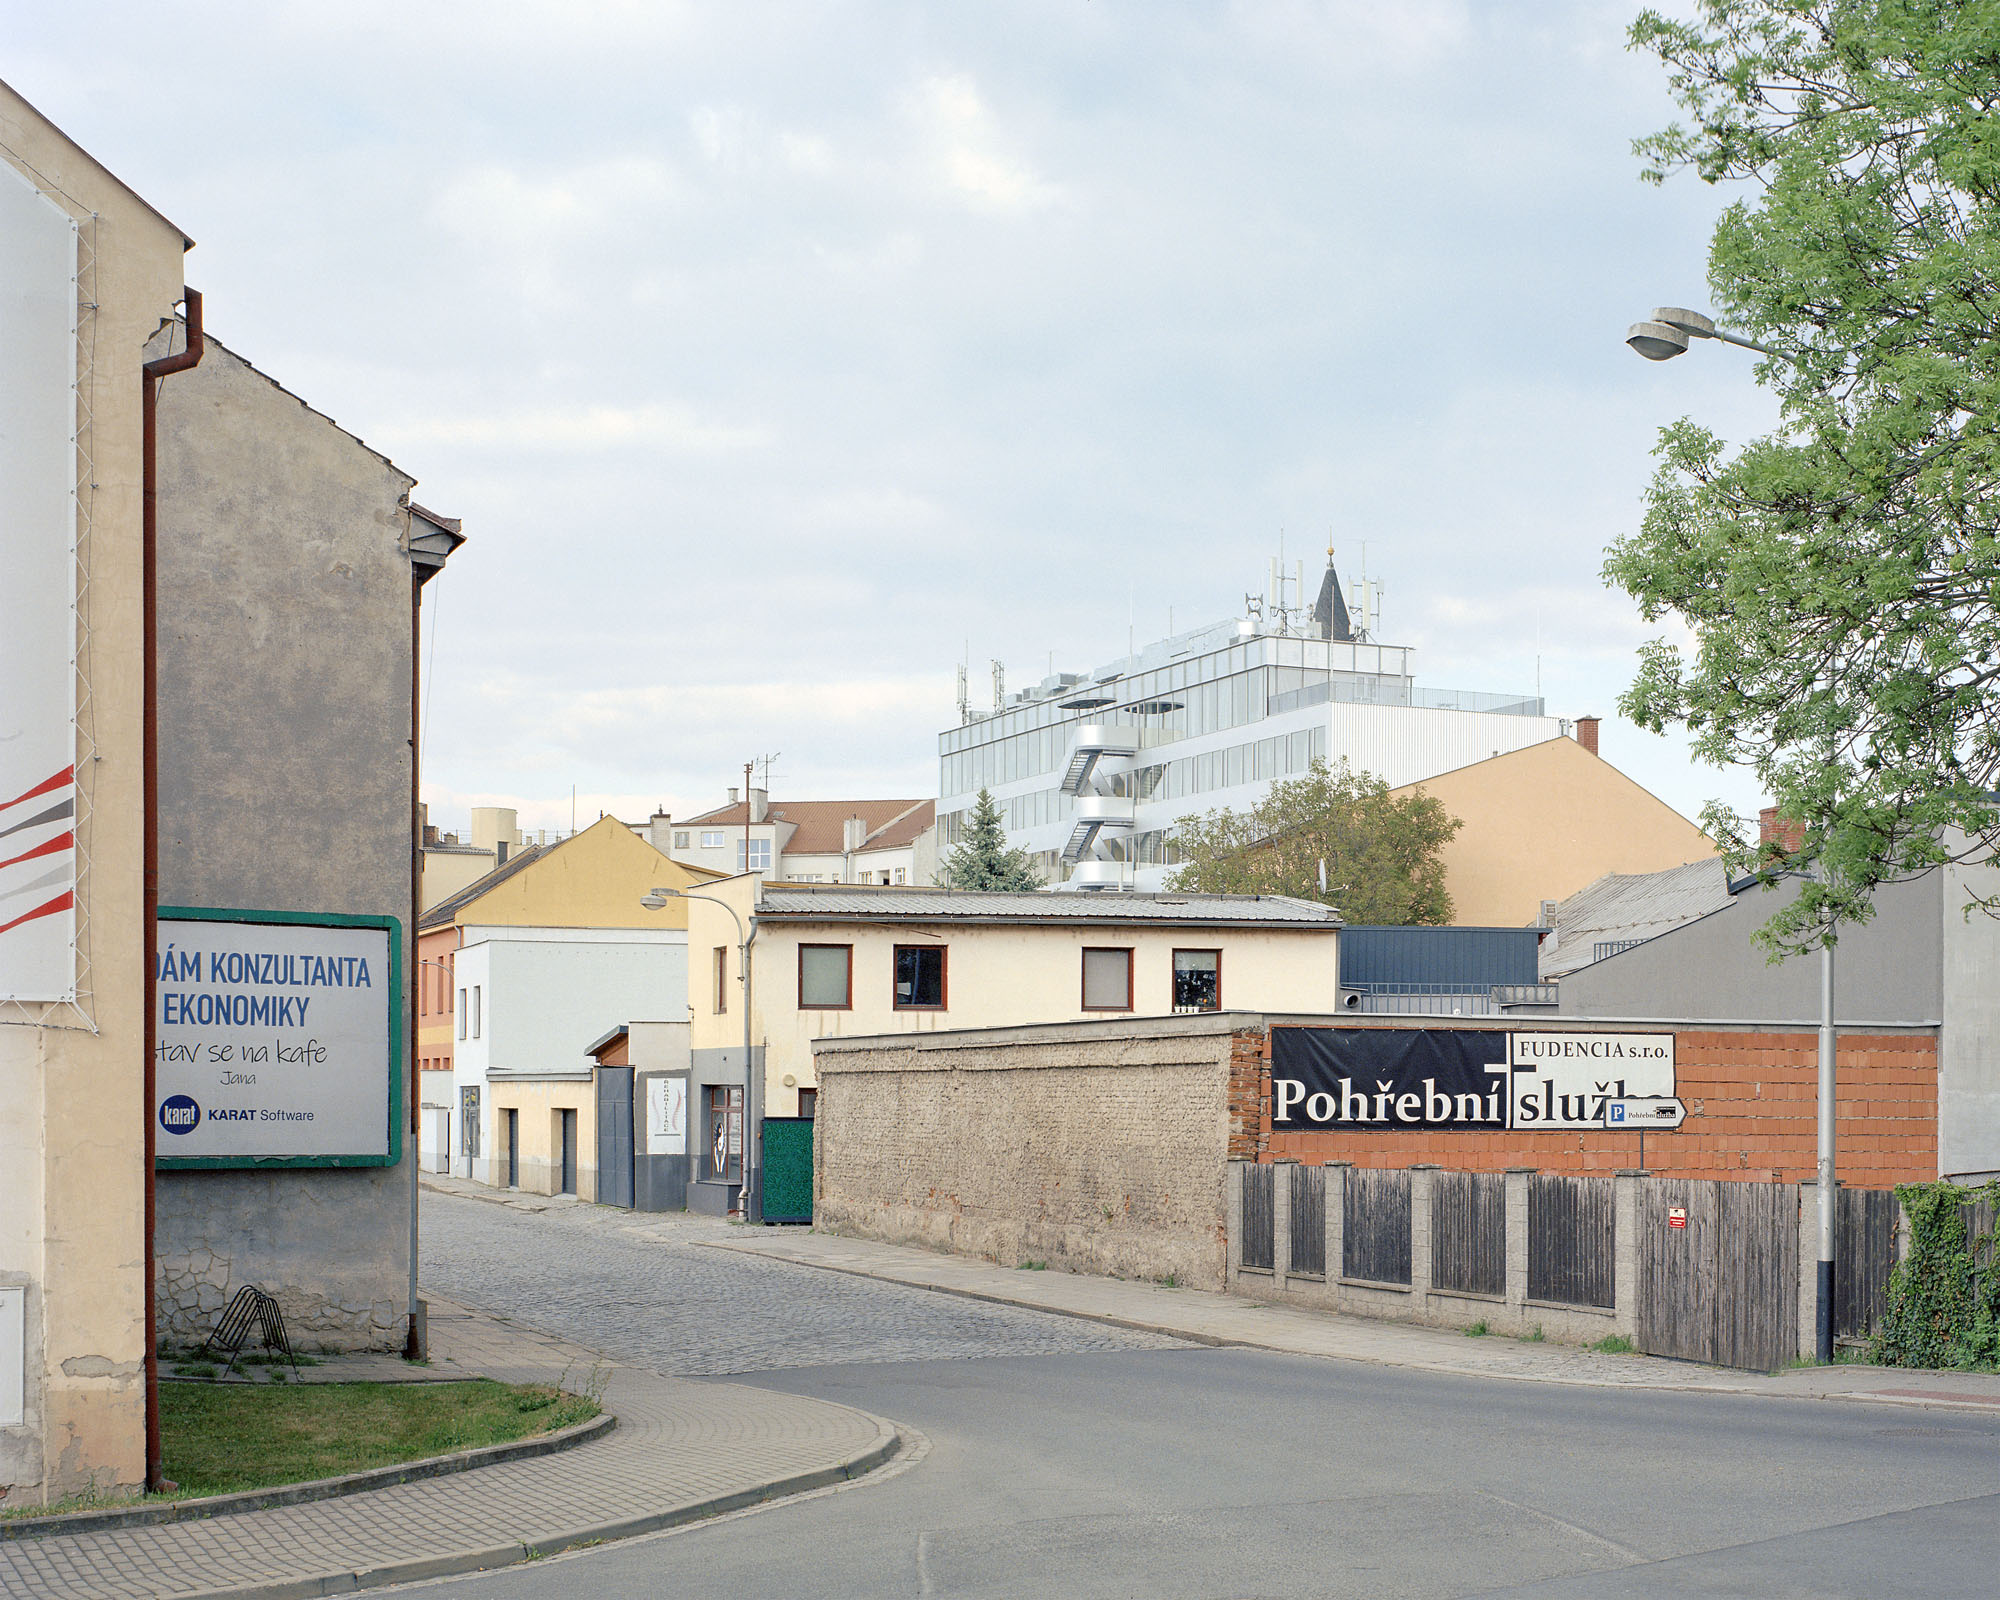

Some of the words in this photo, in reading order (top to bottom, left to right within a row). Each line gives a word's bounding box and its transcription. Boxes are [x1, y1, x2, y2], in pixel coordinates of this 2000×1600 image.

[211, 952, 371, 988] KONZULTANTA
[163, 993, 310, 1027] EKONOMIKY
[208, 1044, 234, 1063] se
[242, 1045, 269, 1063] na
[276, 1039, 328, 1067] kafe
[1520, 1041, 1624, 1058] FUDENCIA
[1629, 1047, 1669, 1059] s.r.o.
[220, 1071, 256, 1086] Jana
[1273, 1078, 1501, 1123] Pohřební
[1519, 1079, 1662, 1122] služ
[208, 1109, 256, 1121] KARAT
[260, 1109, 314, 1121] Software
[1613, 1106, 1622, 1120] P
